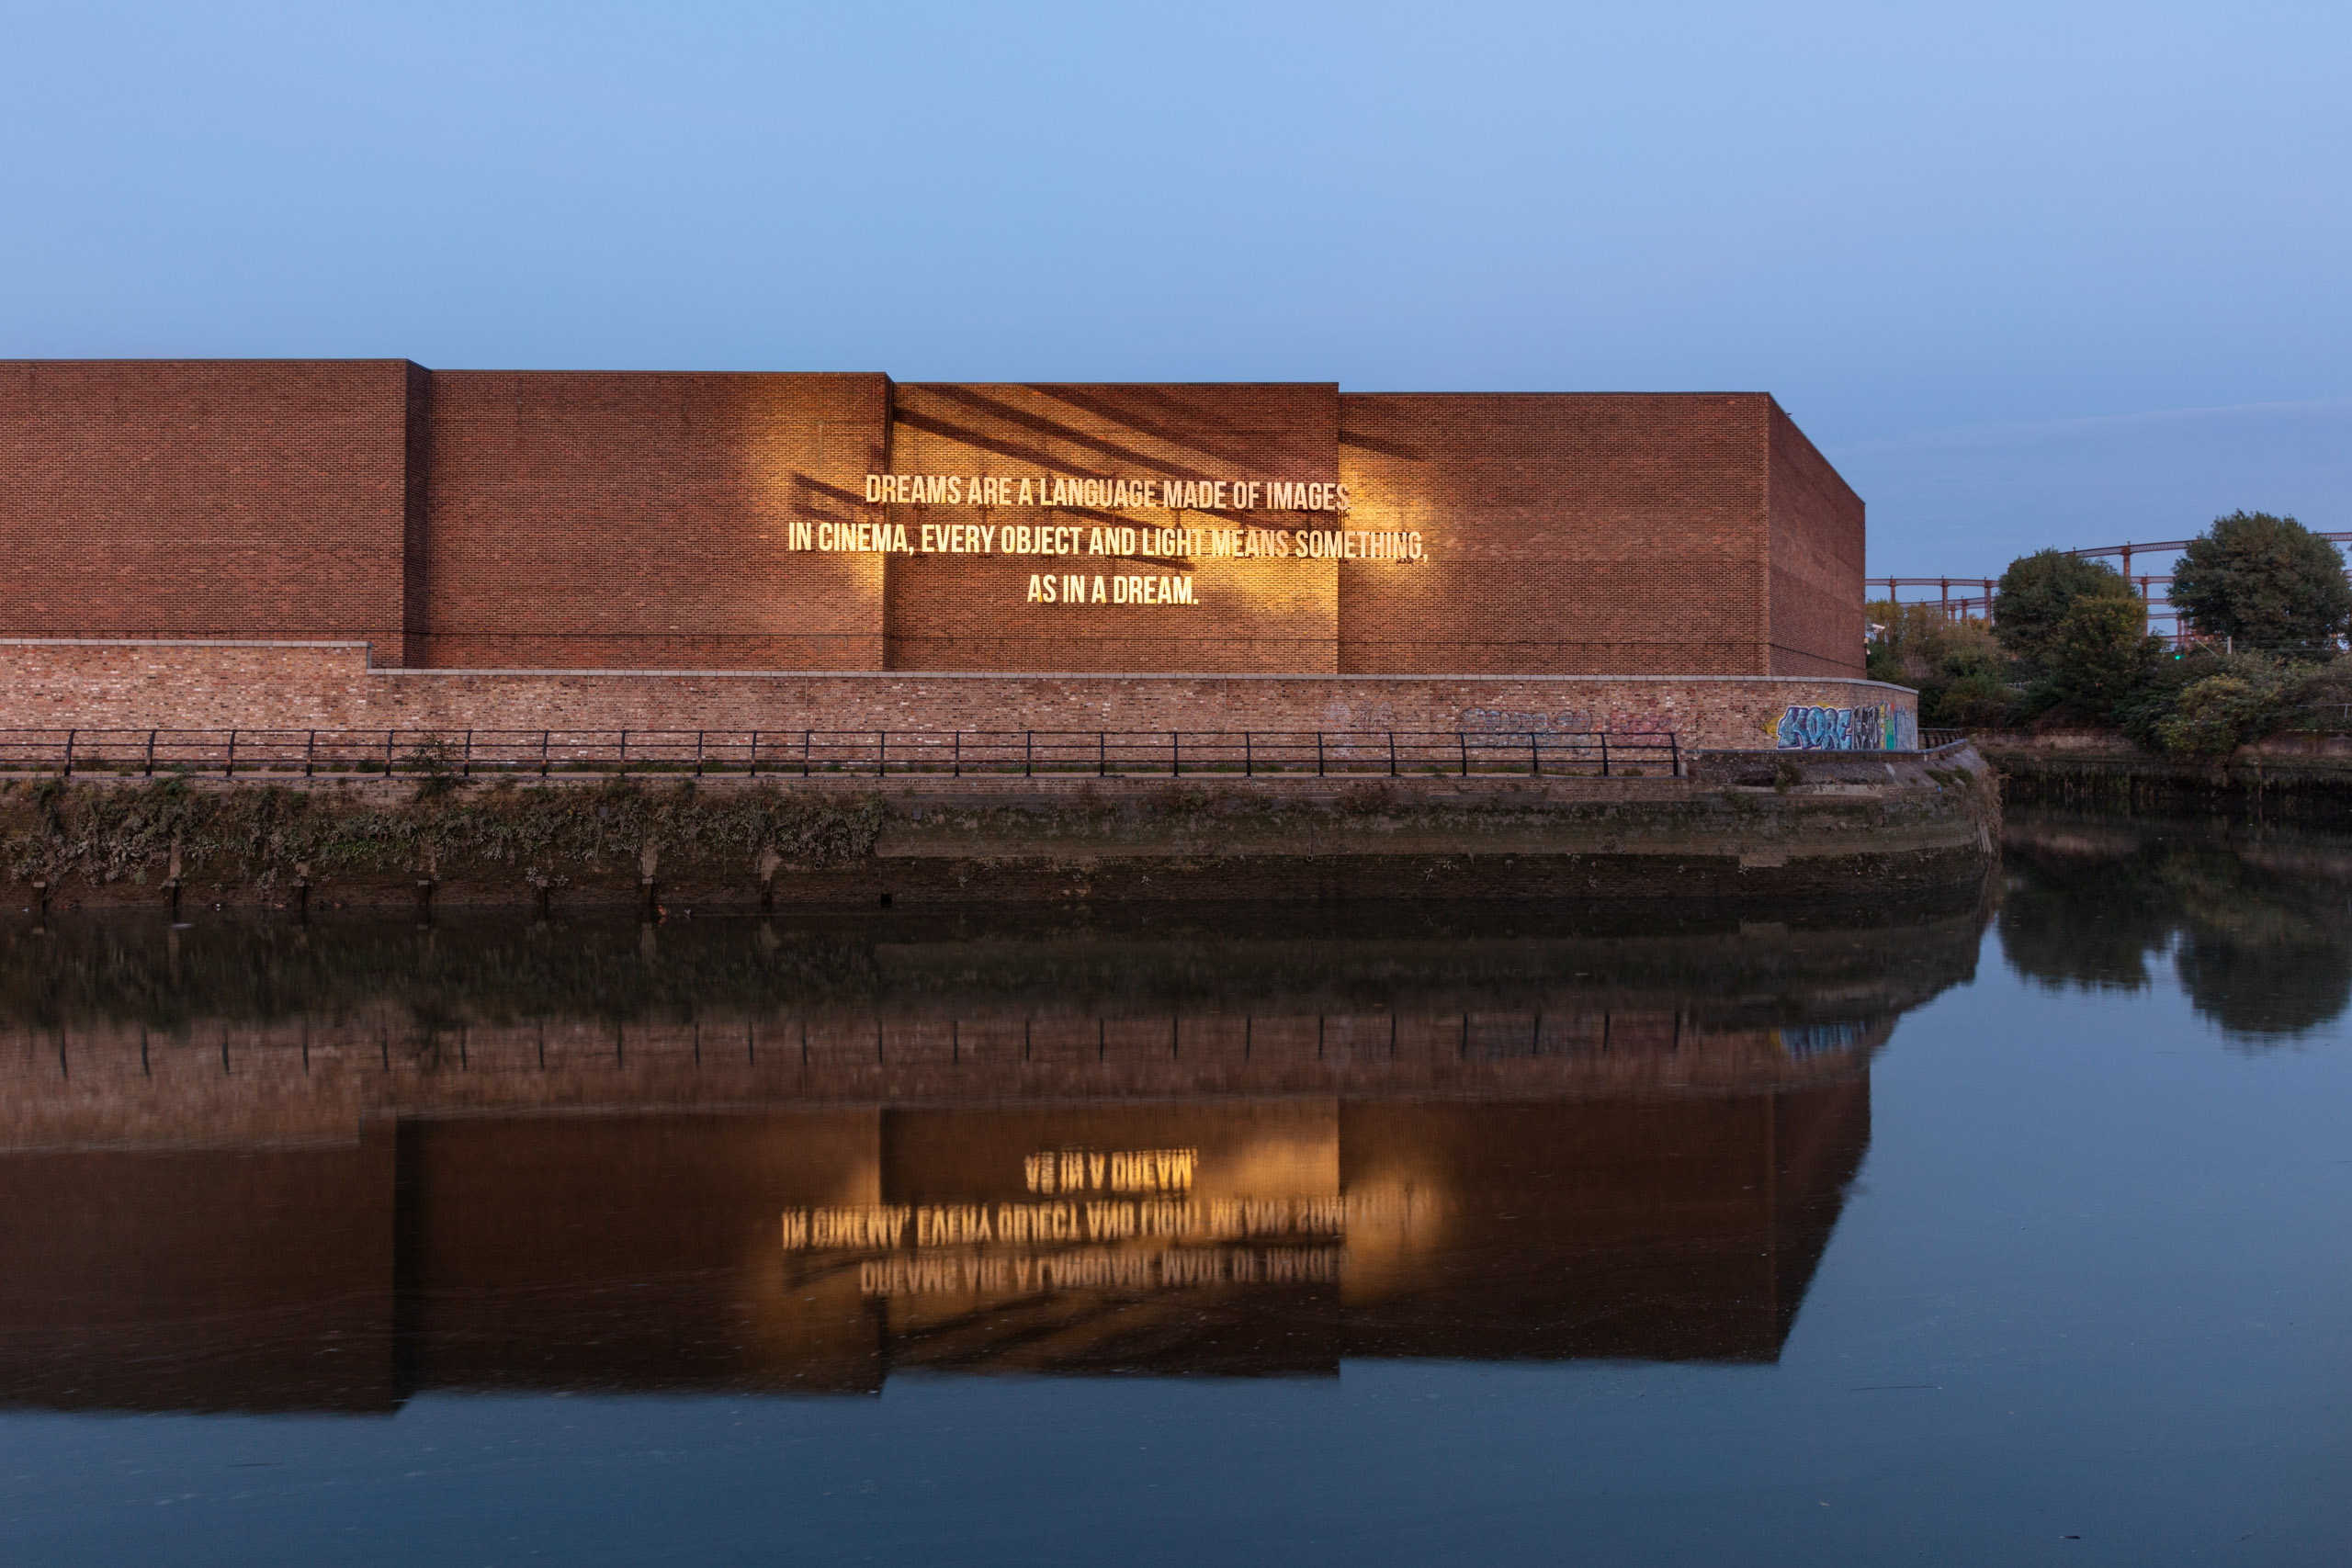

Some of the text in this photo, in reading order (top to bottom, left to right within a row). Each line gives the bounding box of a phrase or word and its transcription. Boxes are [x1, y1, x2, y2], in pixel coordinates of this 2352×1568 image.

[866, 474, 961, 504] DREAMS
[967, 477, 1012, 505] ARE
[1018, 478, 1034, 505] A
[1040, 478, 1157, 507] LANGUAGE
[1163, 479, 1227, 509] MADE
[1233, 480, 1261, 510] OF
[788, 522, 1429, 562] IN CINEMA, EVERY OBJECT AND LIGHT MEANS SOMETHING,
[1027, 574, 1199, 604] AS IN A DREAM.
